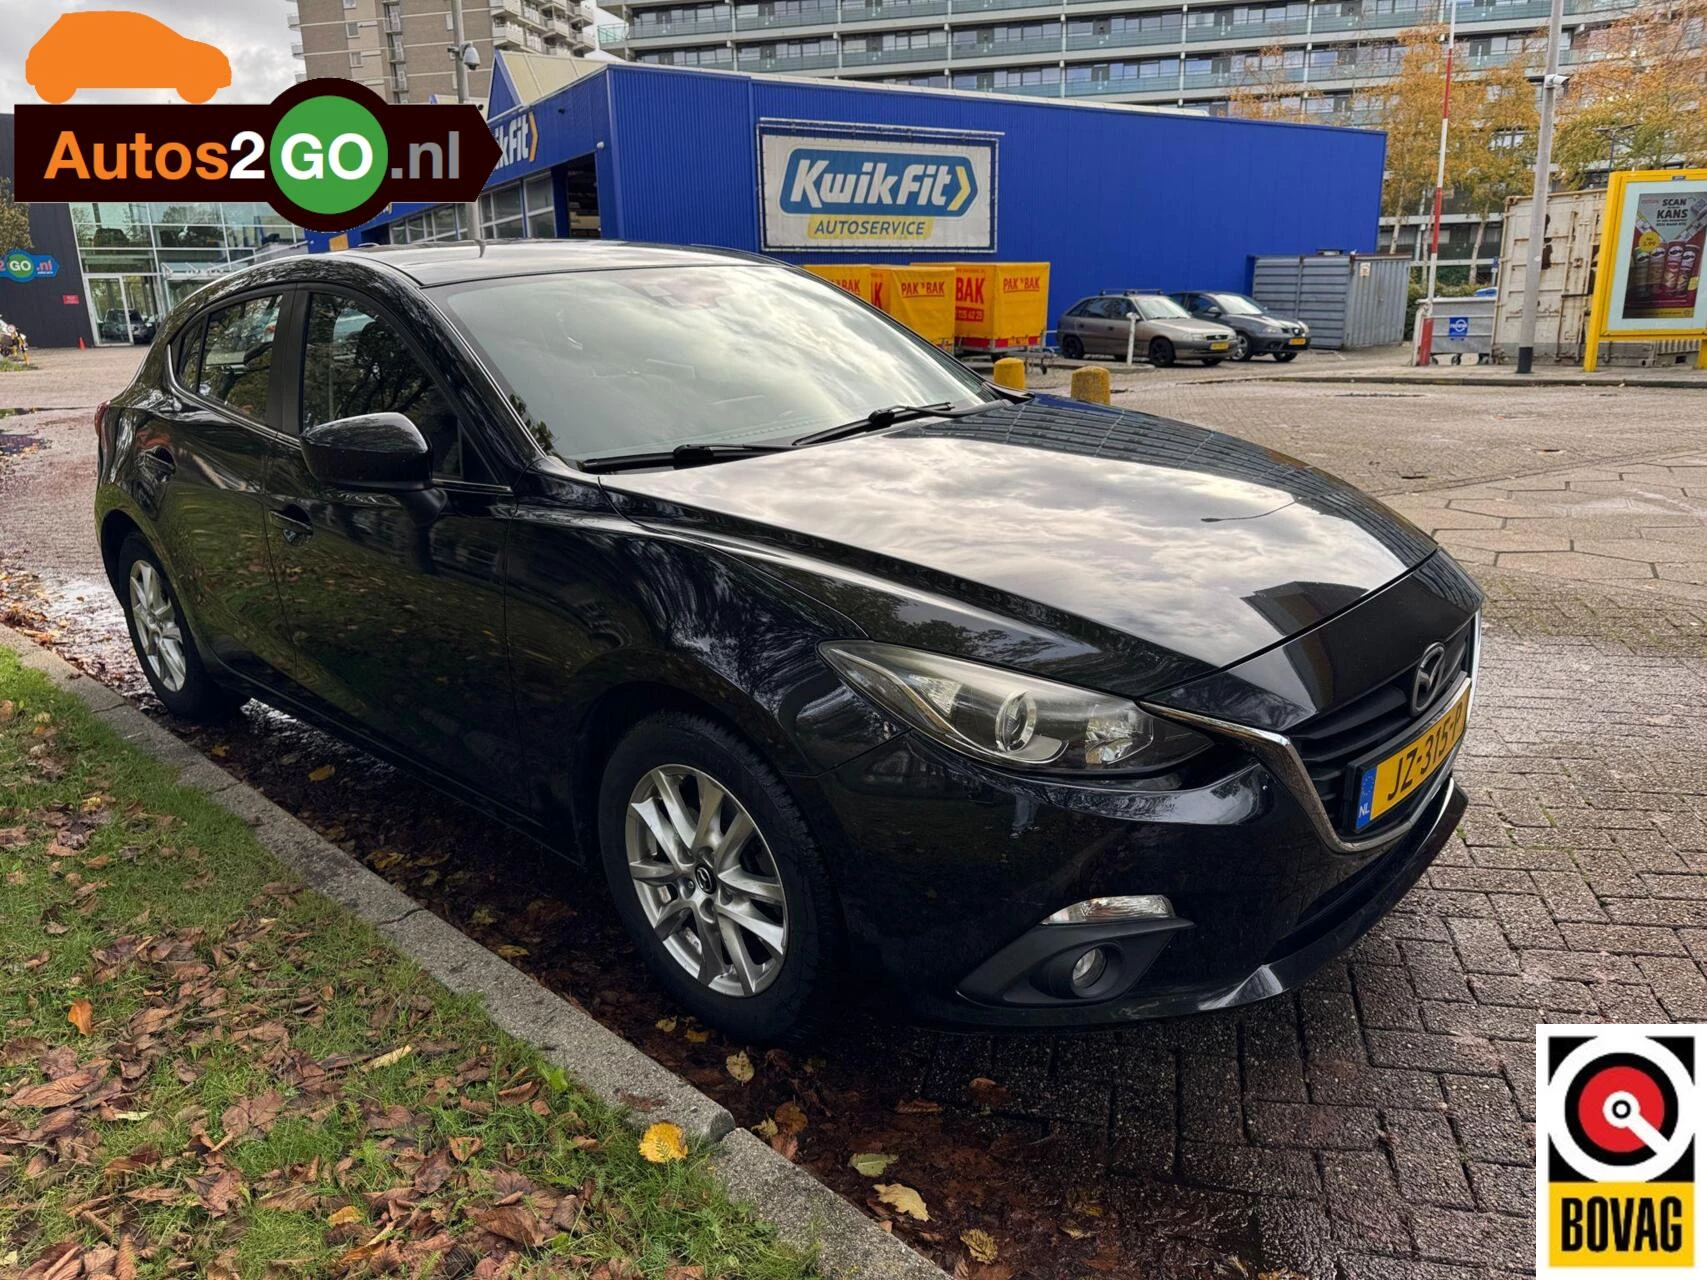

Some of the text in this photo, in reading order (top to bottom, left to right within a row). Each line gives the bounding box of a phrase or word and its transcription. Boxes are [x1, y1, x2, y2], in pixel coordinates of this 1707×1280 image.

[1661, 198, 1688, 207] SCAN
[1656, 208, 1689, 220] KANS
[814, 219, 926, 236] AUTOSERVICE
[901, 282, 919, 296] PAK
[926, 281, 945, 294] BAK
[955, 276, 985, 305] BAK
[1003, 278, 1018, 292] PAK
[1024, 276, 1041, 289] BAK
[1387, 701, 1464, 801] JZ-315-P
[1360, 802, 1371, 818] NL
